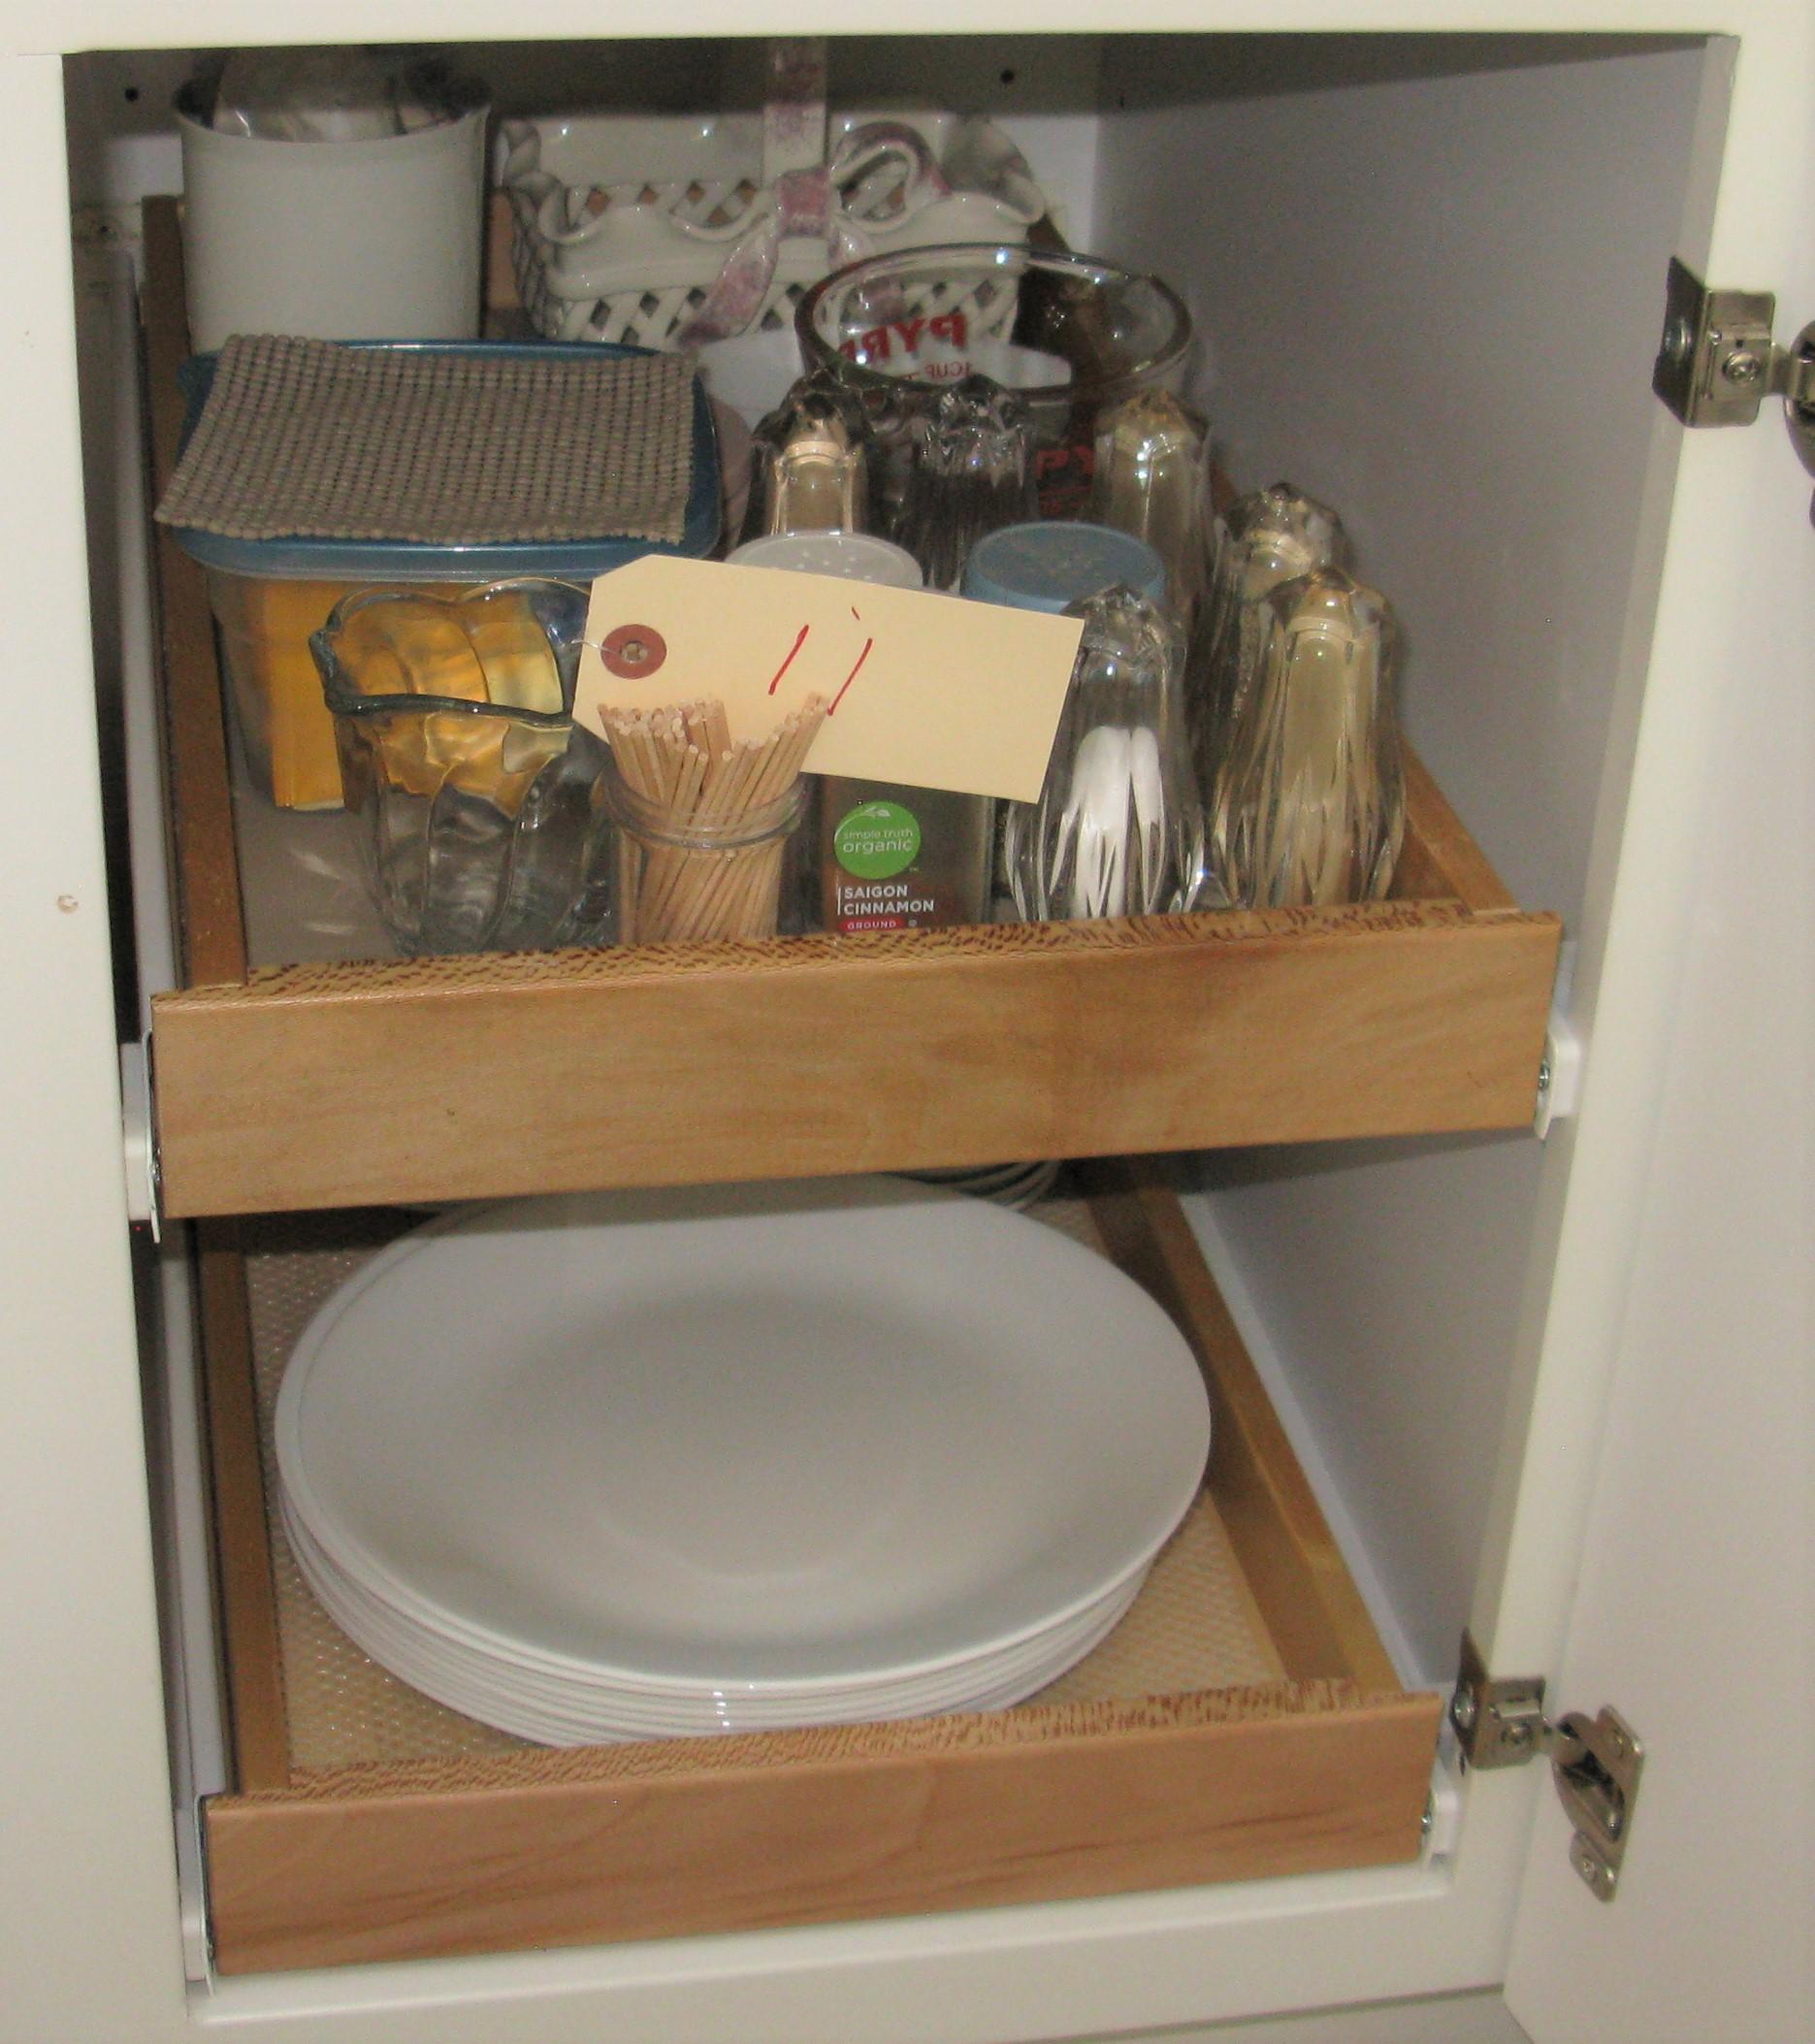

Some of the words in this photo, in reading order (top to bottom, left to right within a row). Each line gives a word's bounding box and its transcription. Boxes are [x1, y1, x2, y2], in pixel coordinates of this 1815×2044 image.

[843, 829, 881, 841] simple
[884, 827, 914, 839] truth
[842, 838, 913, 855] organic
[844, 884, 908, 899] SAIGON
[843, 899, 934, 916] CINNAMON
[847, 920, 897, 930] GROUND
